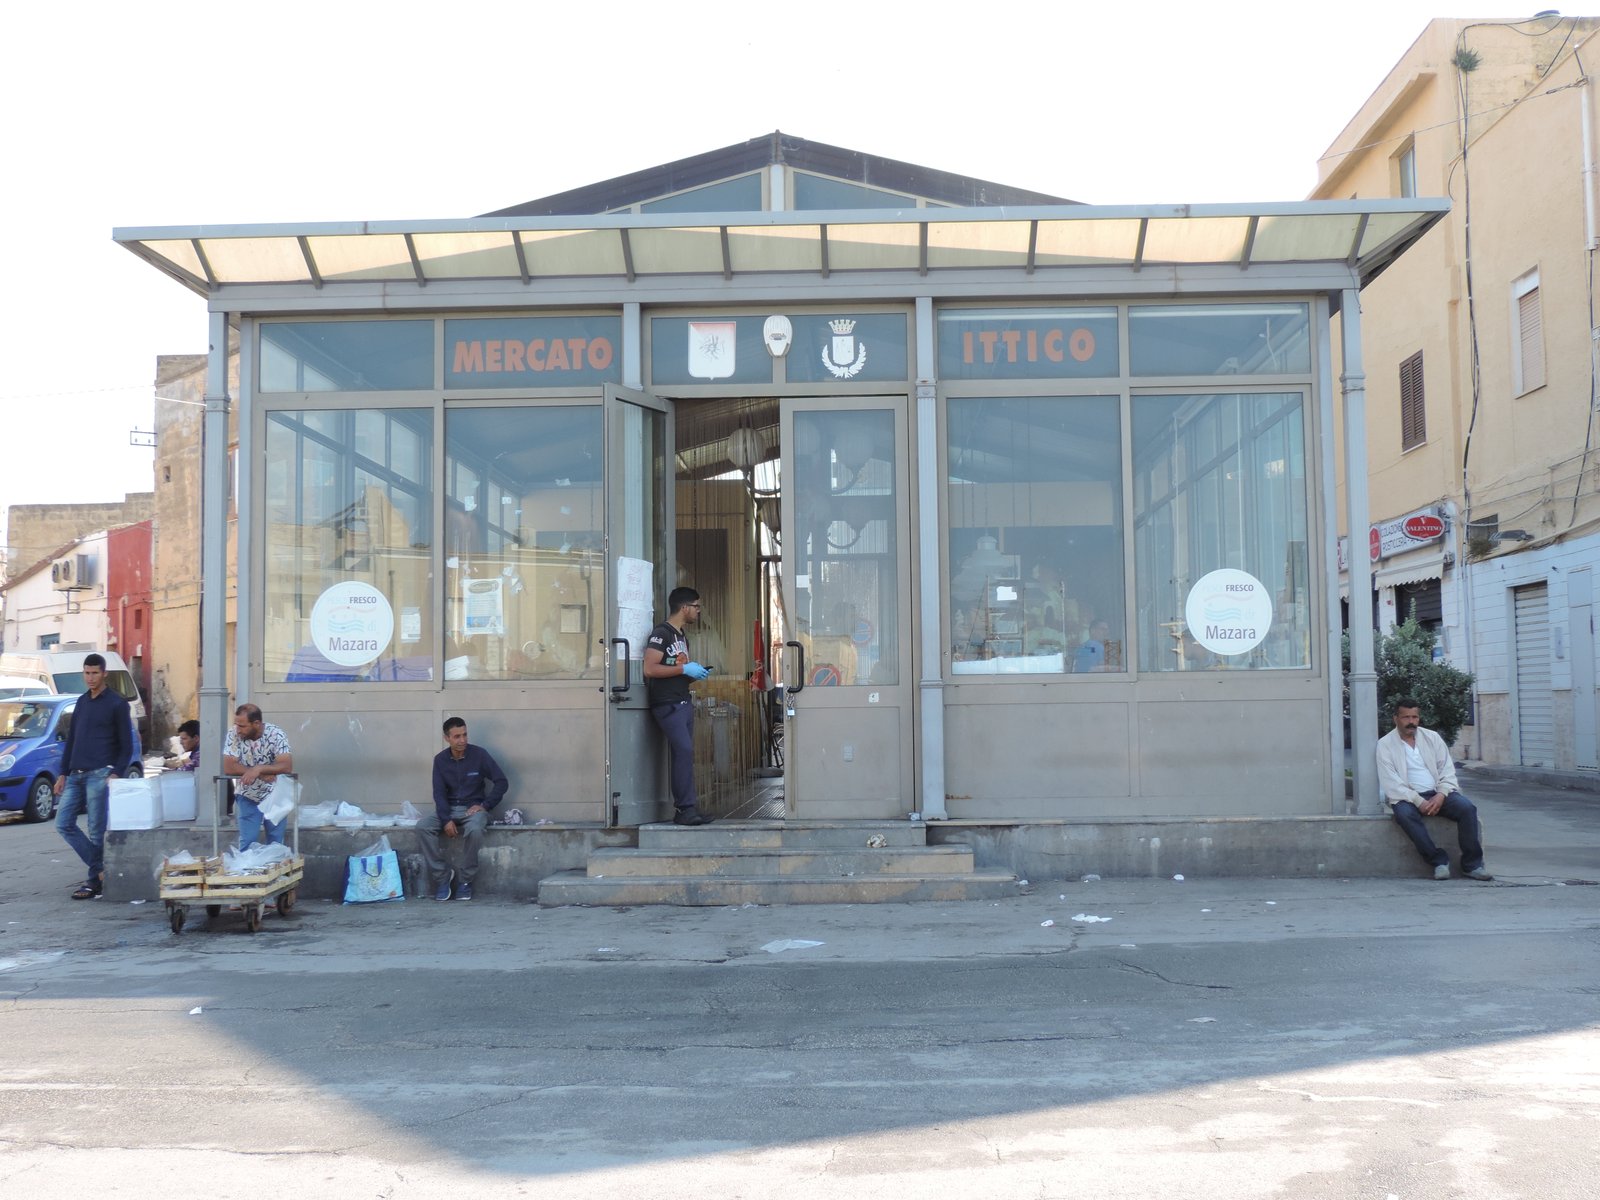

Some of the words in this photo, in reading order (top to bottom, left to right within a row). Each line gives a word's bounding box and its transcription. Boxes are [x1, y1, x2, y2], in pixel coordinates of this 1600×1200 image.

[452, 336, 613, 373] MERCATO
[963, 328, 1096, 364] ITTICO
[1225, 584, 1254, 592] FRESCO
[349, 596, 377, 604] FRESCO
[1206, 625, 1256, 640] Mazara
[328, 636, 378, 652] Mazara
